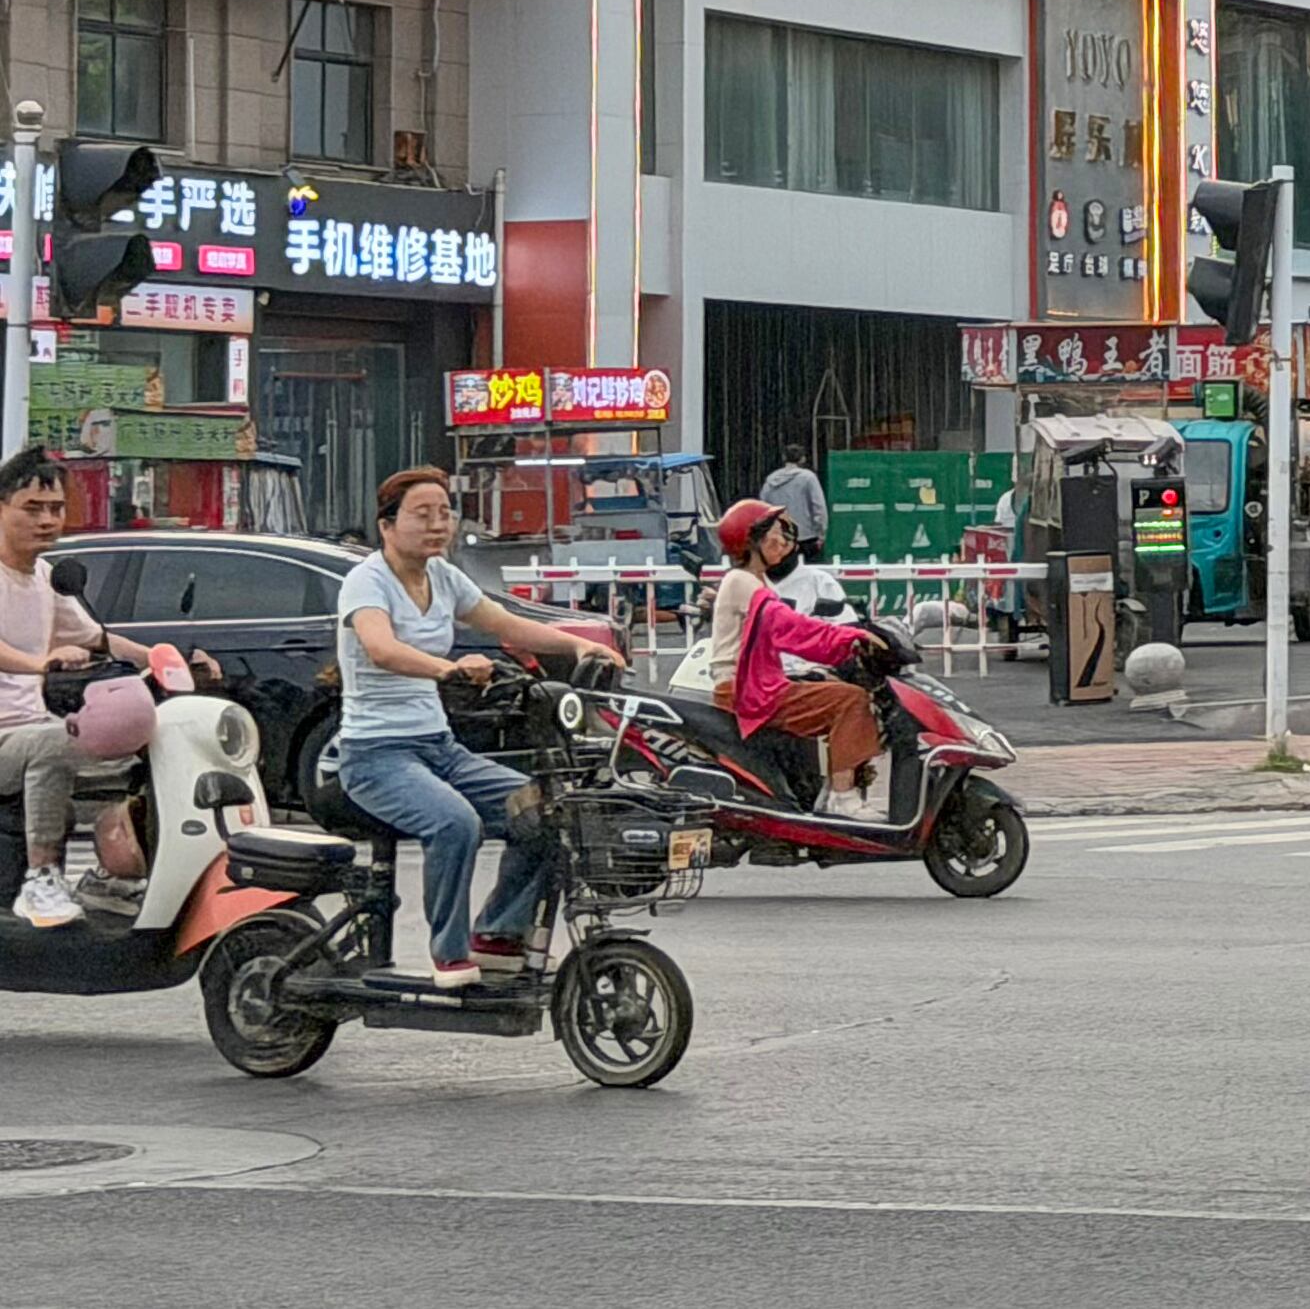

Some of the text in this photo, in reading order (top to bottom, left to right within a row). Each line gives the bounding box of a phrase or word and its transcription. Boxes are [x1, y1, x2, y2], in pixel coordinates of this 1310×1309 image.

[1065, 27, 1132, 90] YOYO
[285, 217, 498, 289] 手机维修基地
[1018, 331, 1170, 379] 黑鸭王者
[1176, 344, 1235, 379] 面筋
[488, 372, 543, 409] 炒鸡
